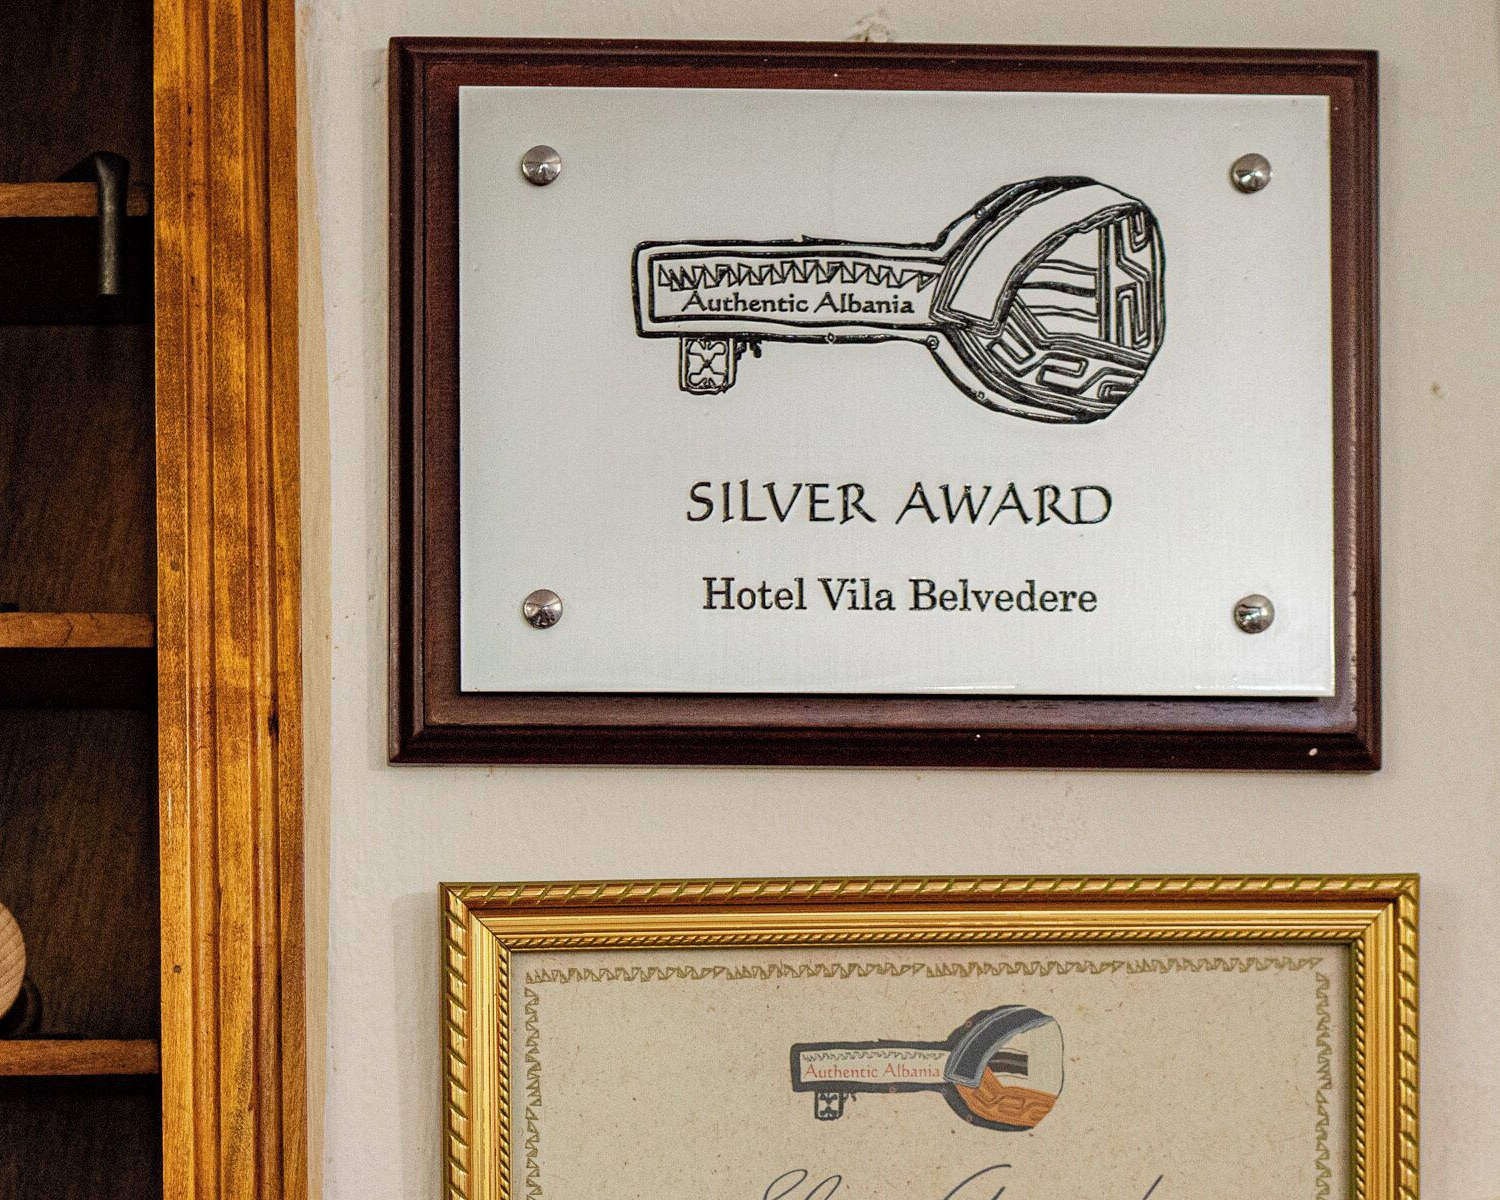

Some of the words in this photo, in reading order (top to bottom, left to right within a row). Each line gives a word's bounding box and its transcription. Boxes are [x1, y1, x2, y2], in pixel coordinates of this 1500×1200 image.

[681, 289, 809, 314] Authentic
[814, 290, 916, 315] Albania
[685, 479, 875, 525] SILVER
[895, 481, 1114, 527] AWARD
[702, 576, 806, 612] Hotel
[817, 577, 896, 612] Vila
[908, 577, 1098, 613] Belvedere
[803, 1063, 878, 1080] Authentic
[884, 1062, 942, 1080] Albania
